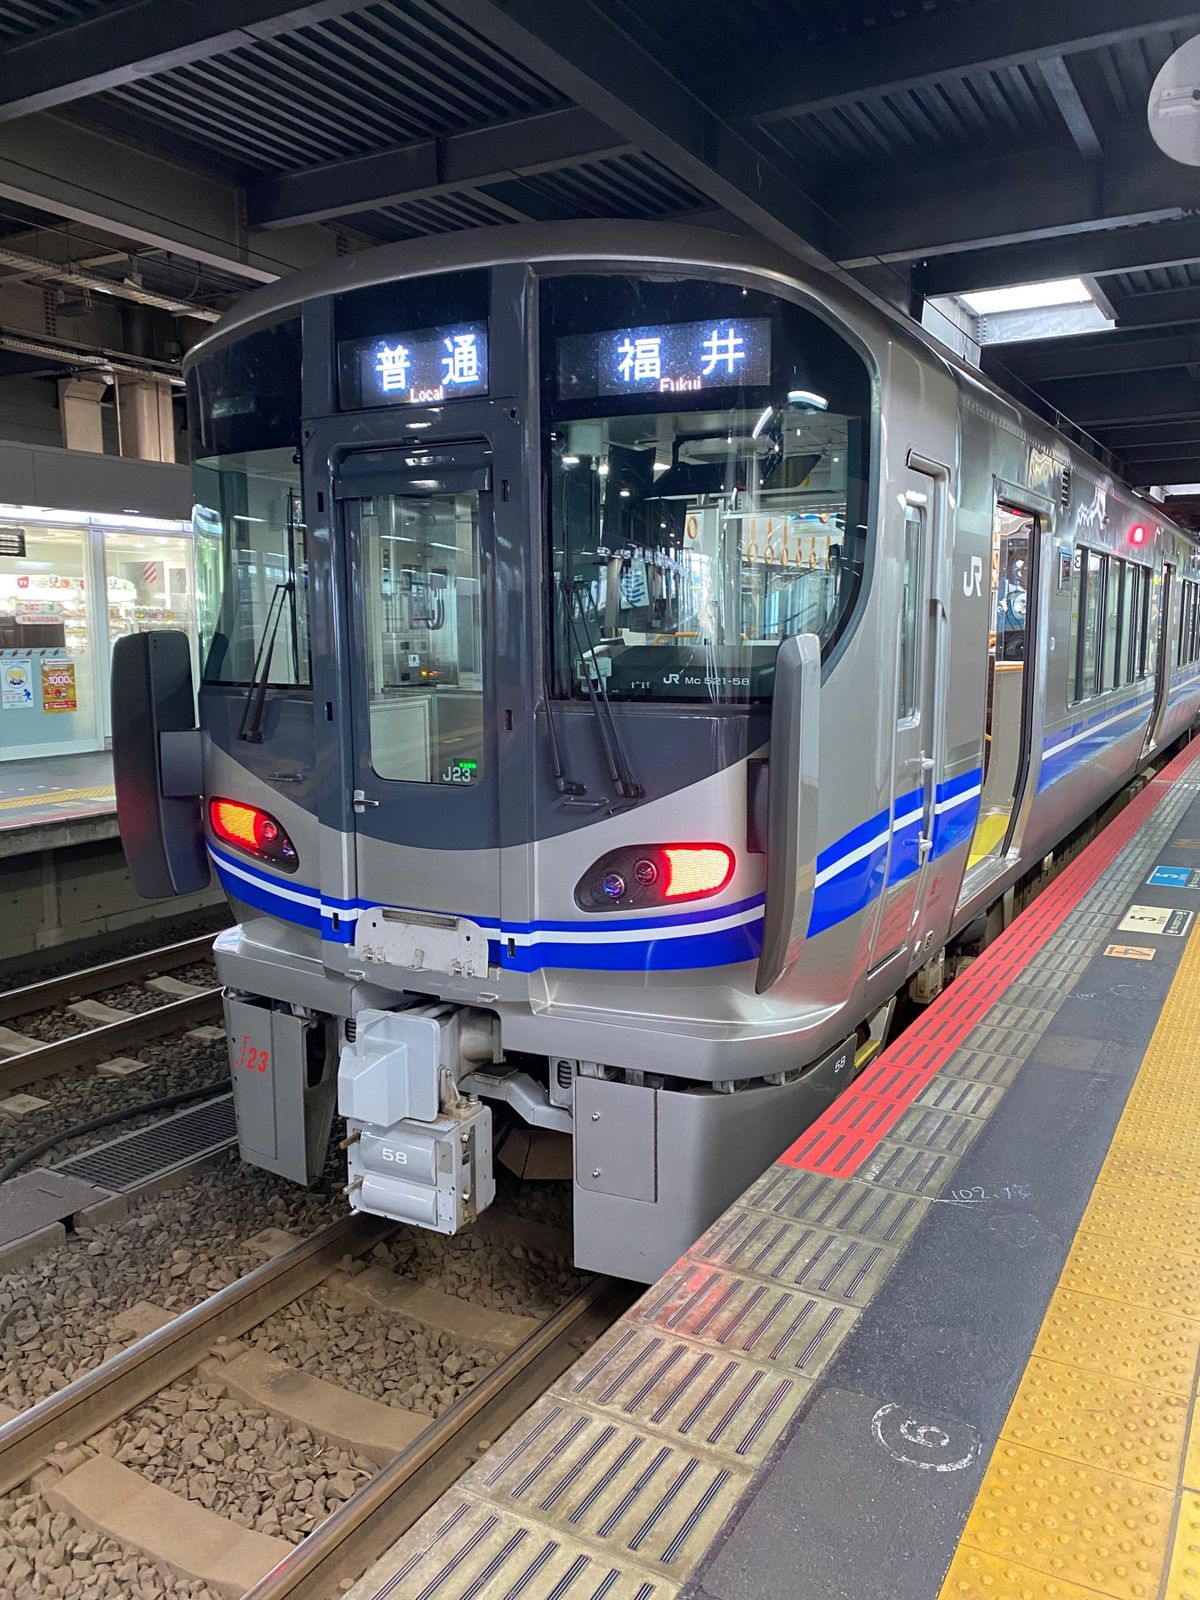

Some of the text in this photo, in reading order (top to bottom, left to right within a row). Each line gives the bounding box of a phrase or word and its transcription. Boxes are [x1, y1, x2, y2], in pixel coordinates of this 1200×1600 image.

[375, 334, 479, 392] 普通
[617, 328, 746, 382] 福井
[660, 376, 702, 393] Fukui
[409, 386, 444, 403] Local
[963, 556, 983, 597] JR
[663, 673, 750, 686] JR Mc 521-58
[442, 766, 471, 783] J23
[235, 1035, 270, 1073] J23
[834, 1055, 847, 1073] 58
[382, 1147, 408, 1165] 58
